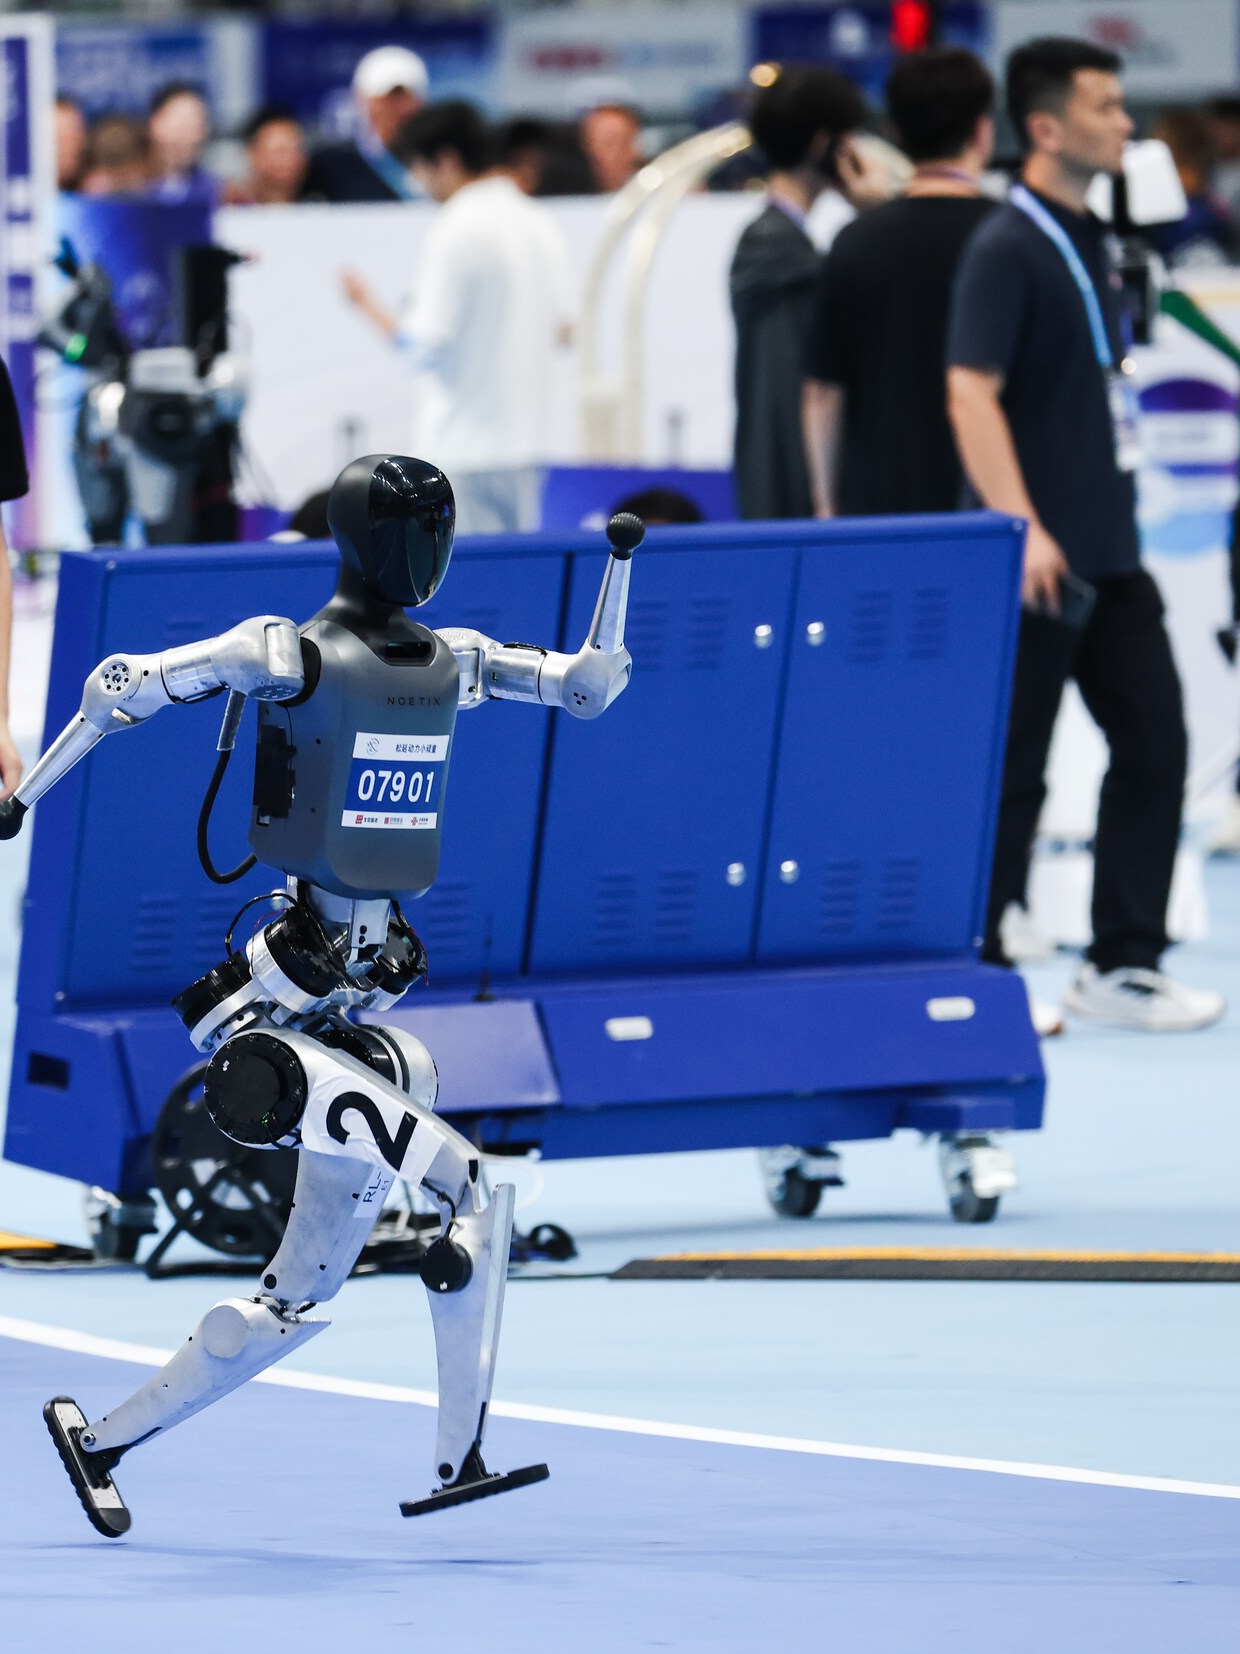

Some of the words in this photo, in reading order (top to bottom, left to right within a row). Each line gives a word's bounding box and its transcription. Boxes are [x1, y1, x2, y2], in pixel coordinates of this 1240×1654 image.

[387, 696, 441, 707] NOETIX
[357, 769, 435, 803] 07901
[326, 1091, 419, 1172] 2
